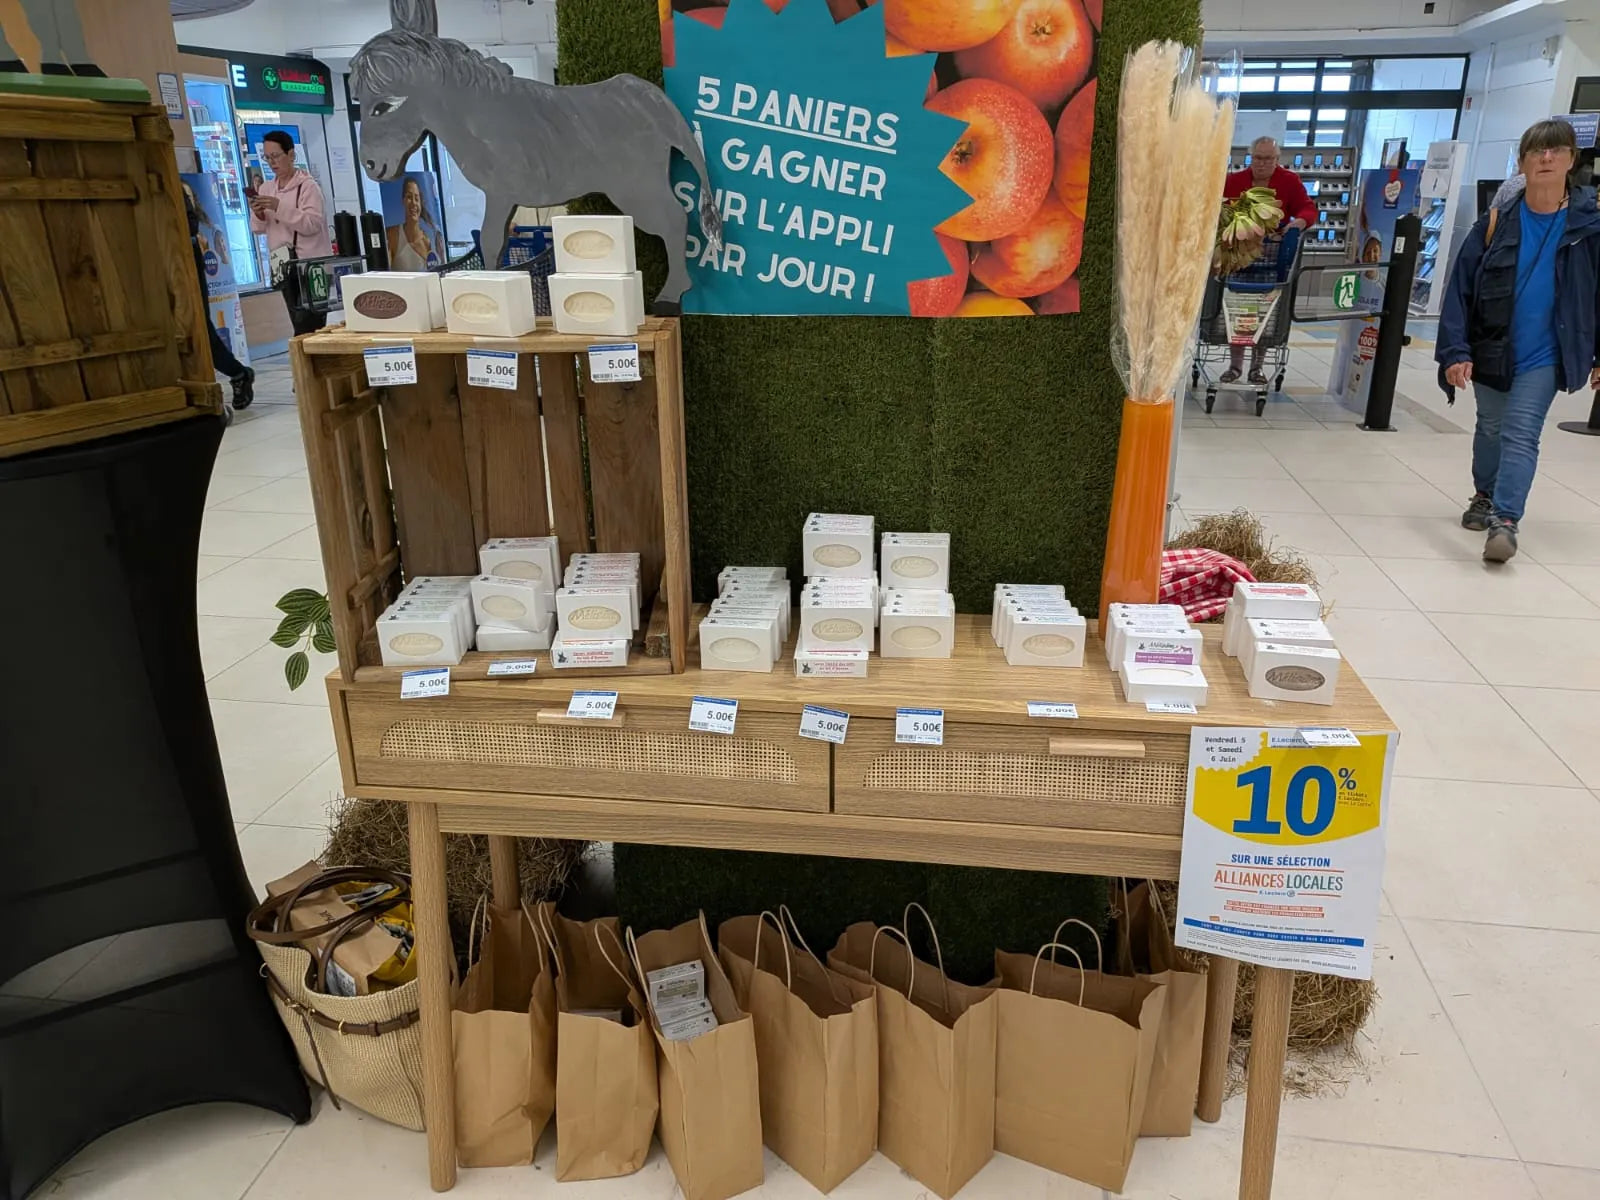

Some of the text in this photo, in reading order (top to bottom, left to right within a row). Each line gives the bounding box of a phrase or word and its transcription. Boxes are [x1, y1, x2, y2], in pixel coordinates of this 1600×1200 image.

[697, 76, 899, 148] 5 PANIERS
[720, 138, 887, 201] GAGNER
[757, 199, 895, 256] L'APPLI
[685, 236, 875, 303] PAR JOUR !
[384, 360, 414, 372] 5.00€
[608, 358, 637, 369] 5.00€
[486, 364, 516, 376] 5.00€
[419, 678, 447, 688] 5.00€
[586, 701, 614, 709] 5.00€
[707, 710, 734, 722] 5.00€
[818, 720, 845, 733] 5.00€
[913, 722, 941, 733] 5.00€
[1231, 854, 1331, 867] SUR UNE SÉLECTION
[1214, 870, 1344, 891] ALLIANCES LOCALES
